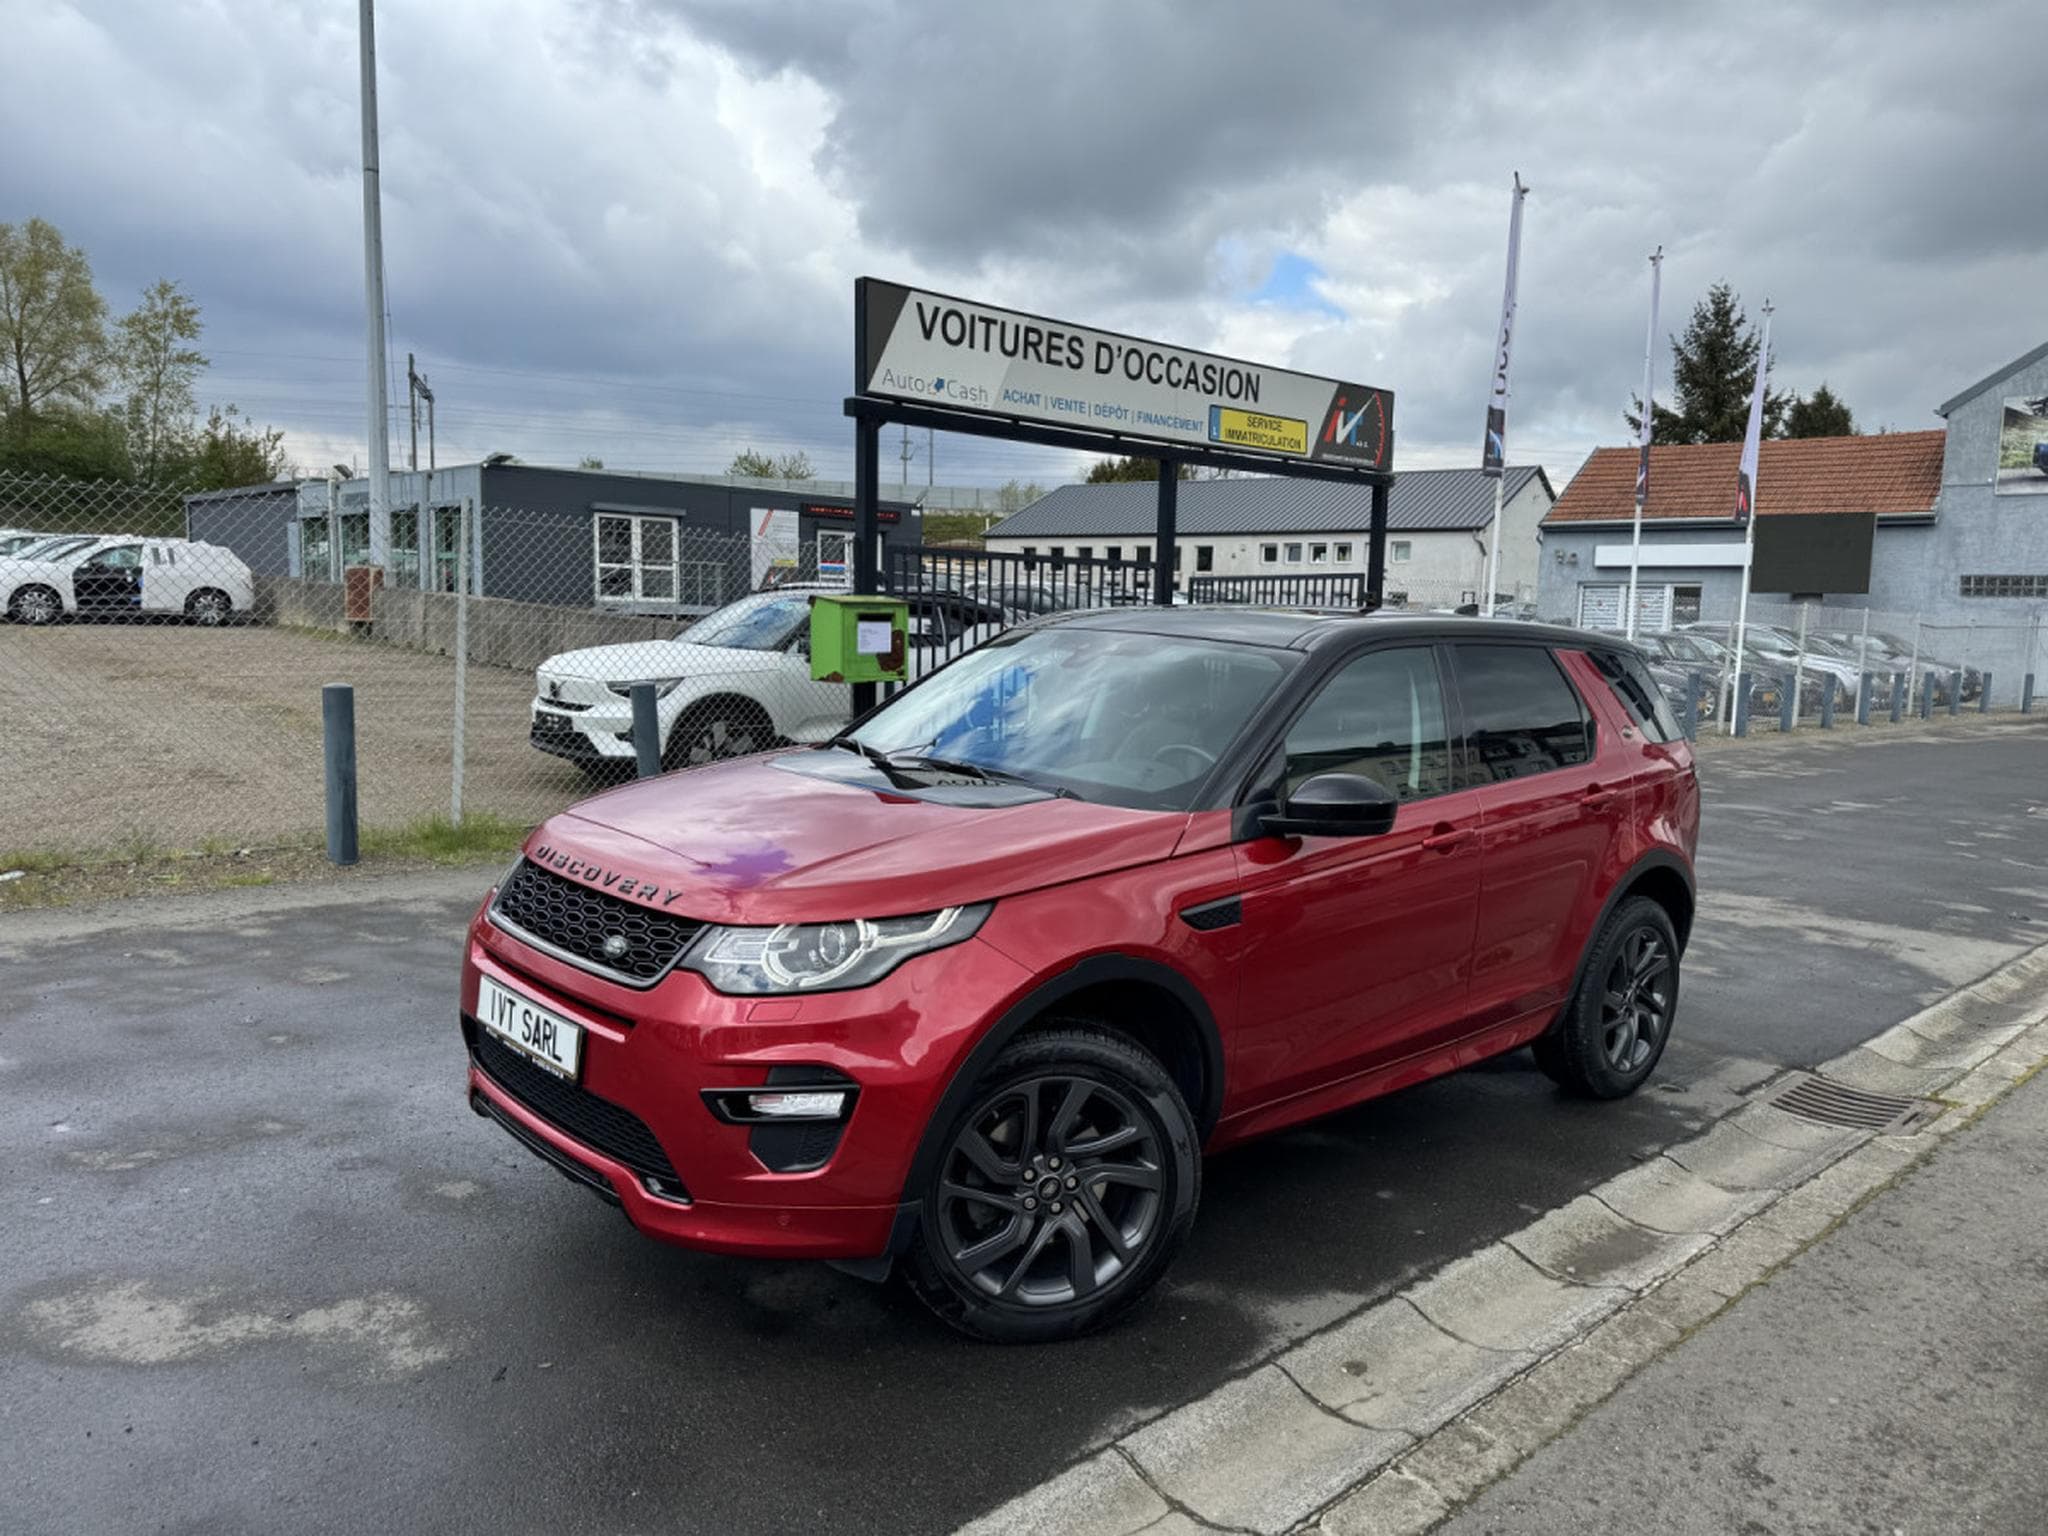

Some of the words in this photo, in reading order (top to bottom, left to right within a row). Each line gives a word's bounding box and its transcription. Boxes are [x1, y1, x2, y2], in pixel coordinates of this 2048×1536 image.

[916, 302, 1084, 370] VOITURES
[1095, 341, 1260, 402] D'OCCASION
[946, 379, 989, 402] Cash
[1003, 389, 1041, 407] ACHAT
[1051, 395, 1086, 415] VENTE
[1094, 402, 1129, 421] DÉPÔT
[1136, 410, 1204, 433] FINANCEMENT
[1225, 427, 1302, 450] IMMATRICULATION
[1247, 415, 1283, 433] SERVICE
[537, 845, 682, 906] DISCOVERY
[491, 988, 516, 1032] IVT
[521, 1008, 562, 1062] SARL
